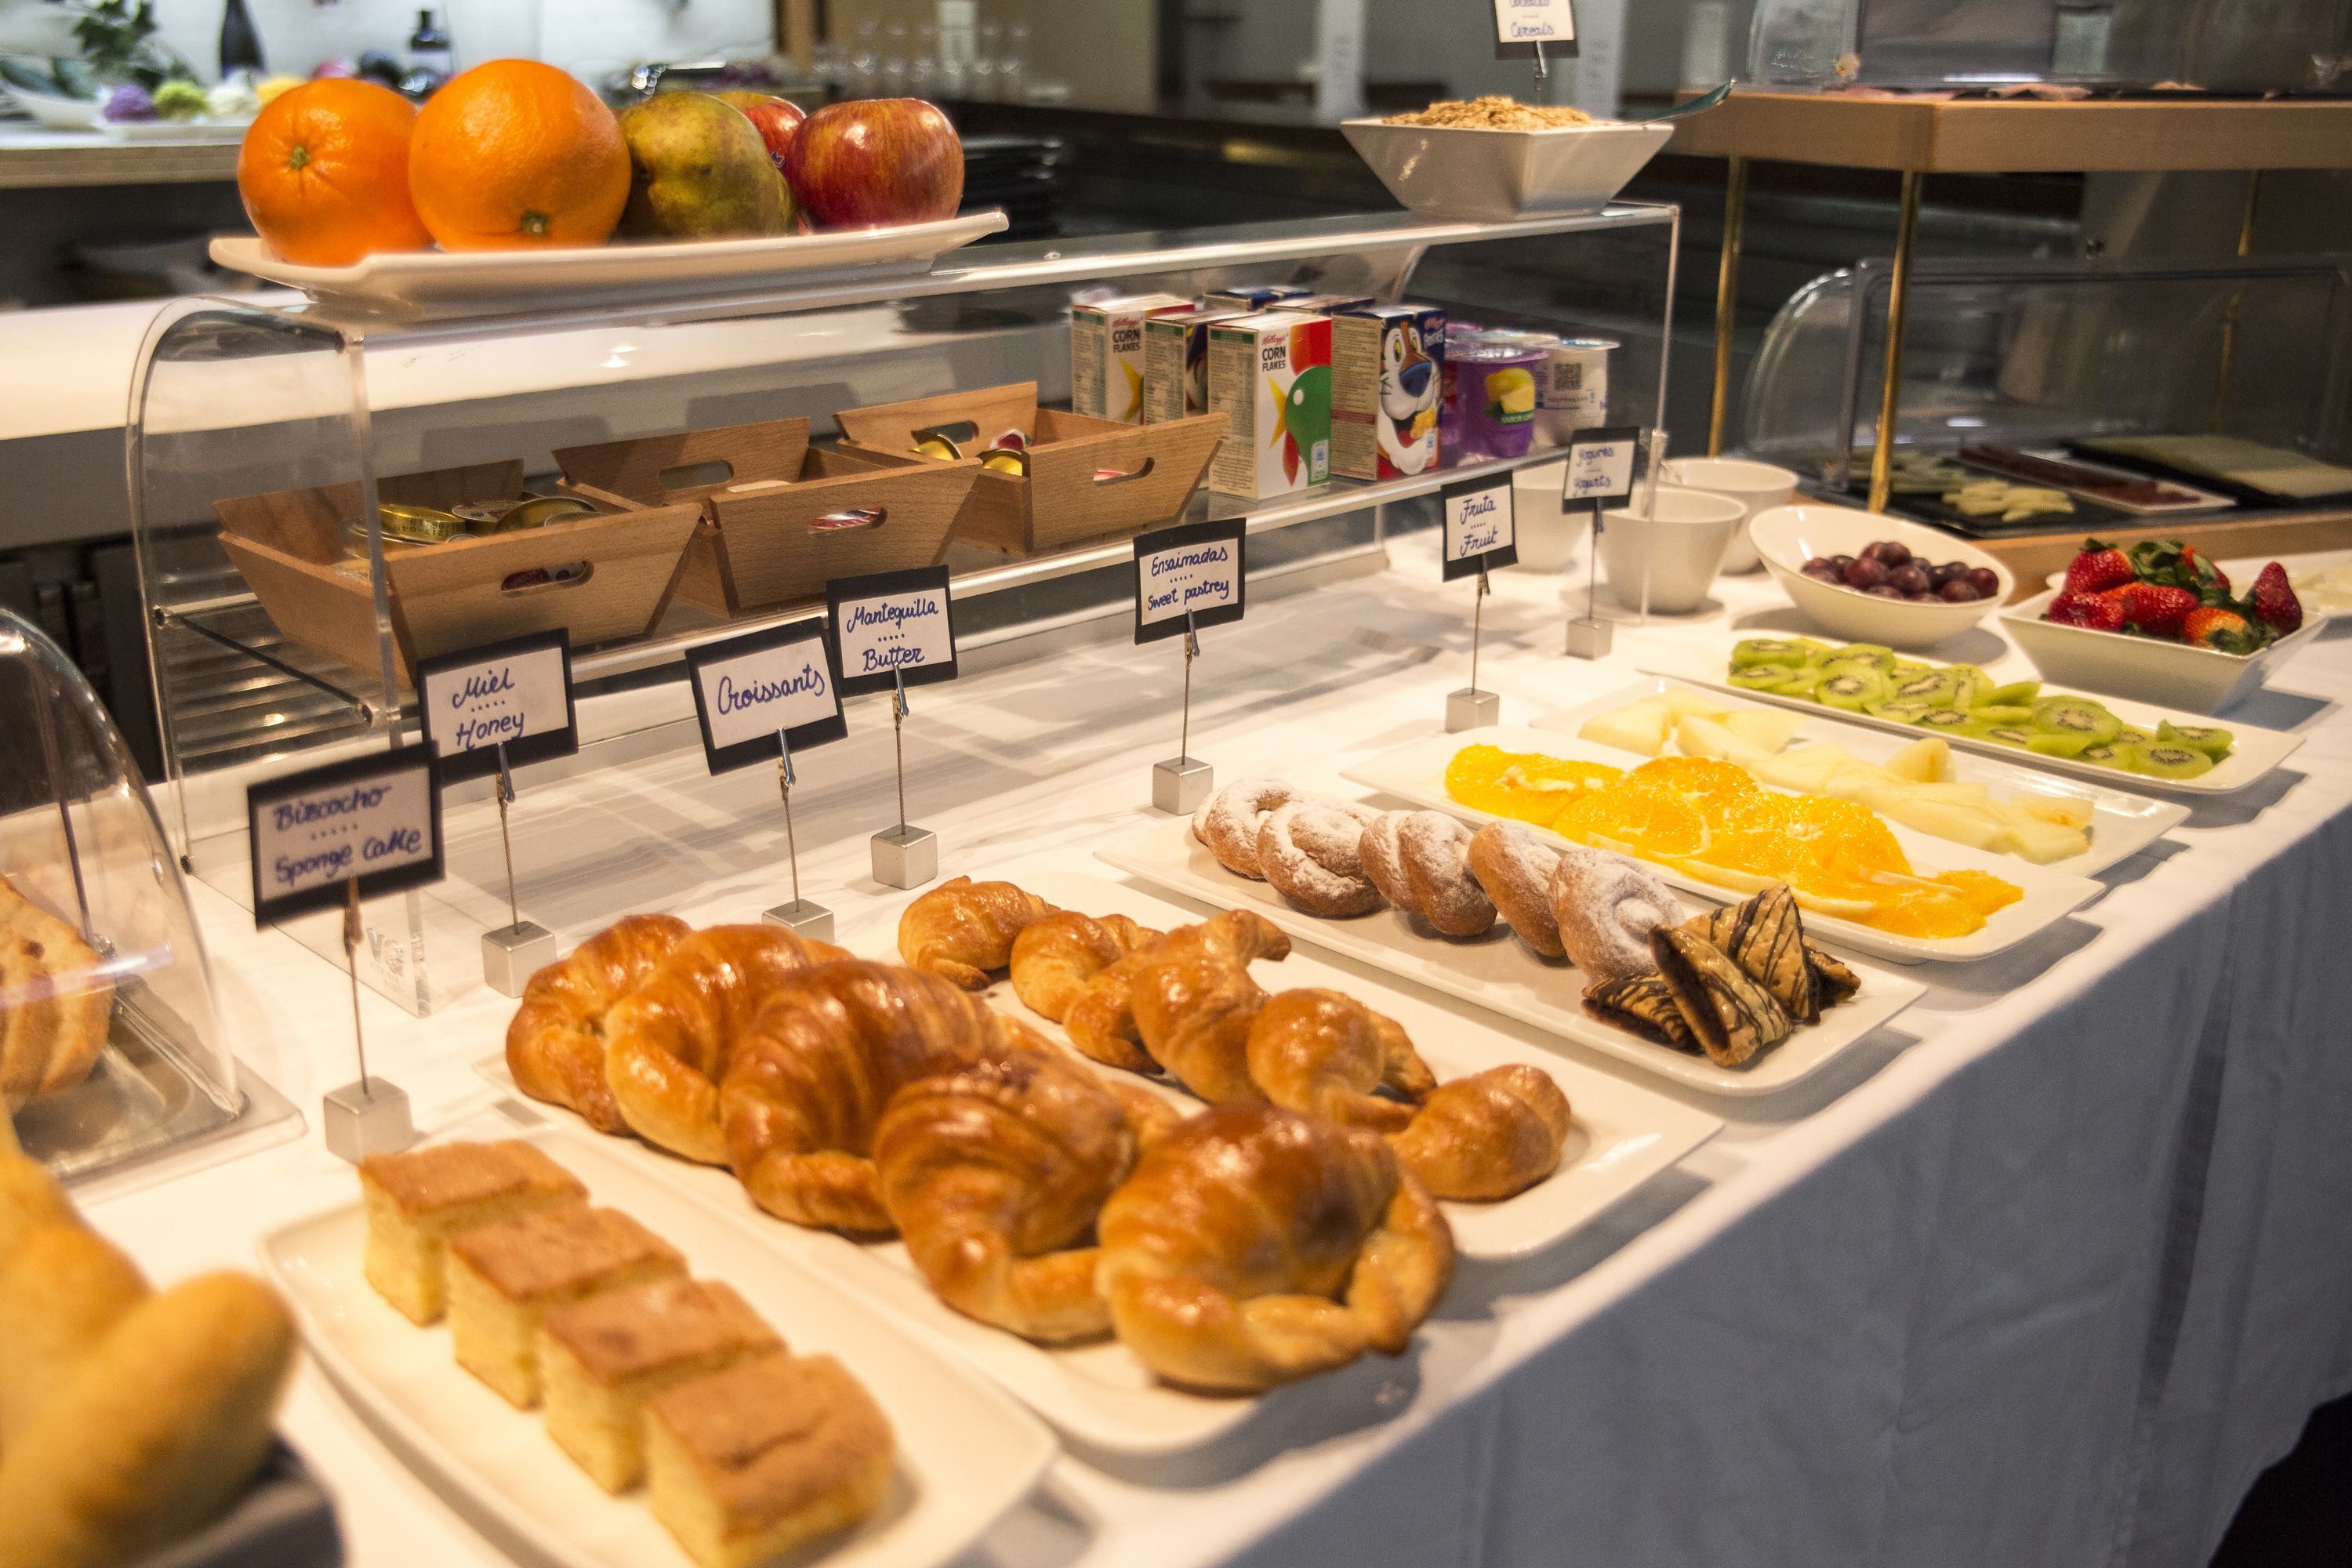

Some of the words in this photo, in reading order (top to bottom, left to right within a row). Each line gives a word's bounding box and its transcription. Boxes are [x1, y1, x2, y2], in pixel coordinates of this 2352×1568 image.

[1112, 328, 1141, 343] CORN
[1113, 342, 1141, 353] FLAKES
[1262, 346, 1287, 361] CORN
[1262, 360, 1287, 372] FLAKES
[1459, 495, 1497, 524] Fruta
[1459, 525, 1498, 557] Fruit
[1151, 546, 1228, 577] Ensaimadas
[1148, 588, 1178, 611] Sweet
[1183, 580, 1229, 605] pastrey
[847, 598, 939, 633] Mantequilla
[862, 645, 926, 673] Butter
[452, 667, 515, 709] Miel
[717, 663, 826, 716] Croissants
[456, 712, 524, 751] Honey
[275, 844, 353, 887] Sponge
